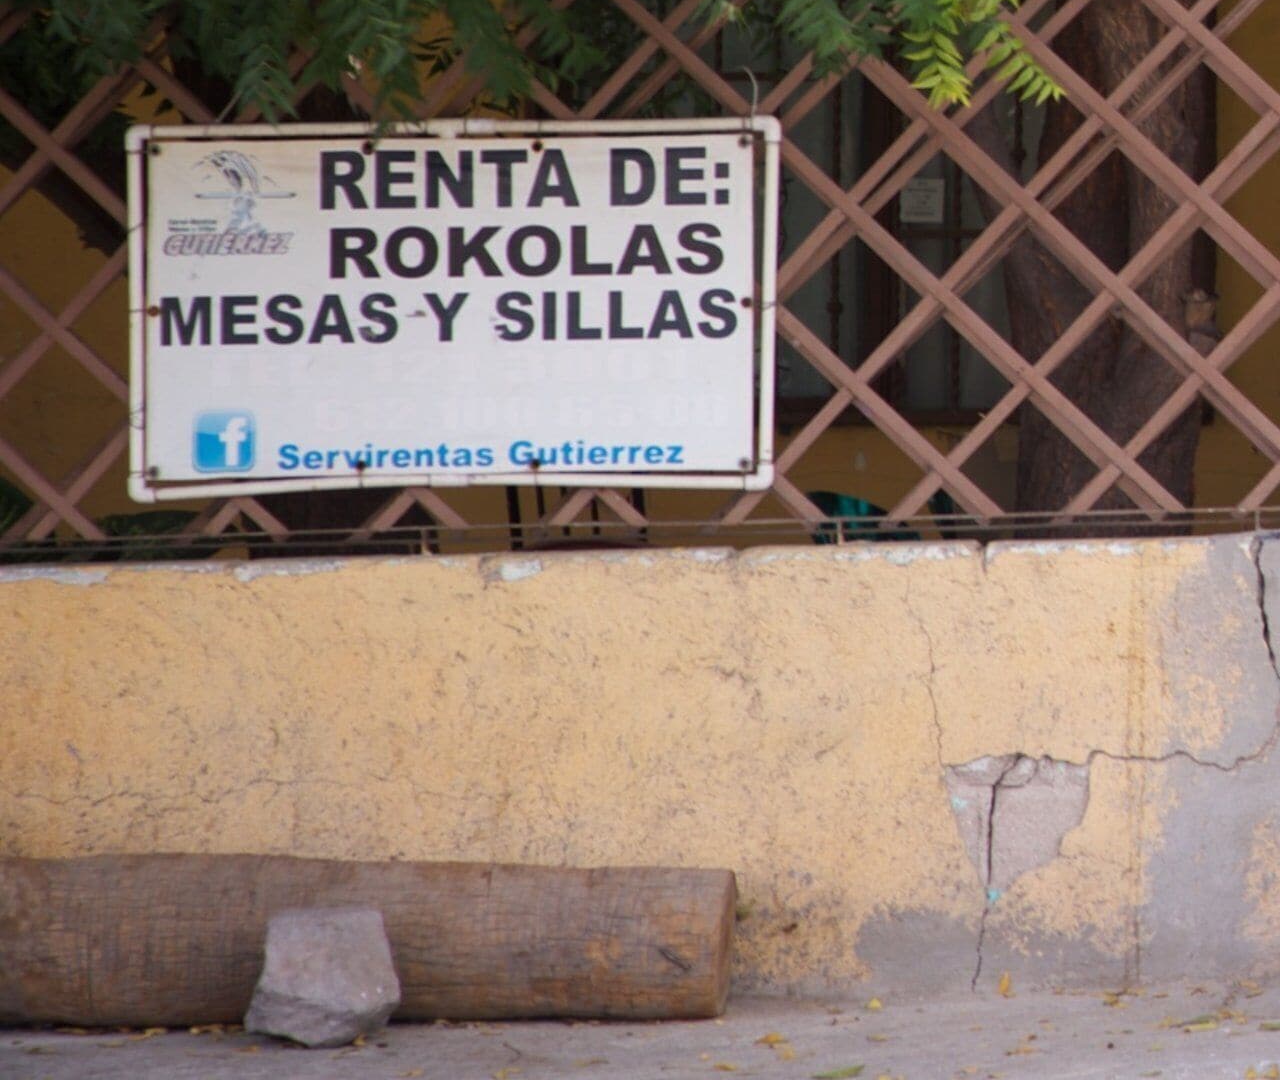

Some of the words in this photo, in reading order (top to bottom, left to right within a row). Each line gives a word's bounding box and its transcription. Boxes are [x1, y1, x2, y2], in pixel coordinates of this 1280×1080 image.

[318, 148, 580, 210] RENTA
[609, 147, 731, 207] DE:
[328, 222, 725, 280] ROKOLAS
[159, 292, 399, 347] MESAS
[422, 291, 470, 342] Y
[494, 287, 740, 342] SILLAS
[277, 441, 494, 470] Servirentas
[508, 439, 685, 468] Gutierrez
